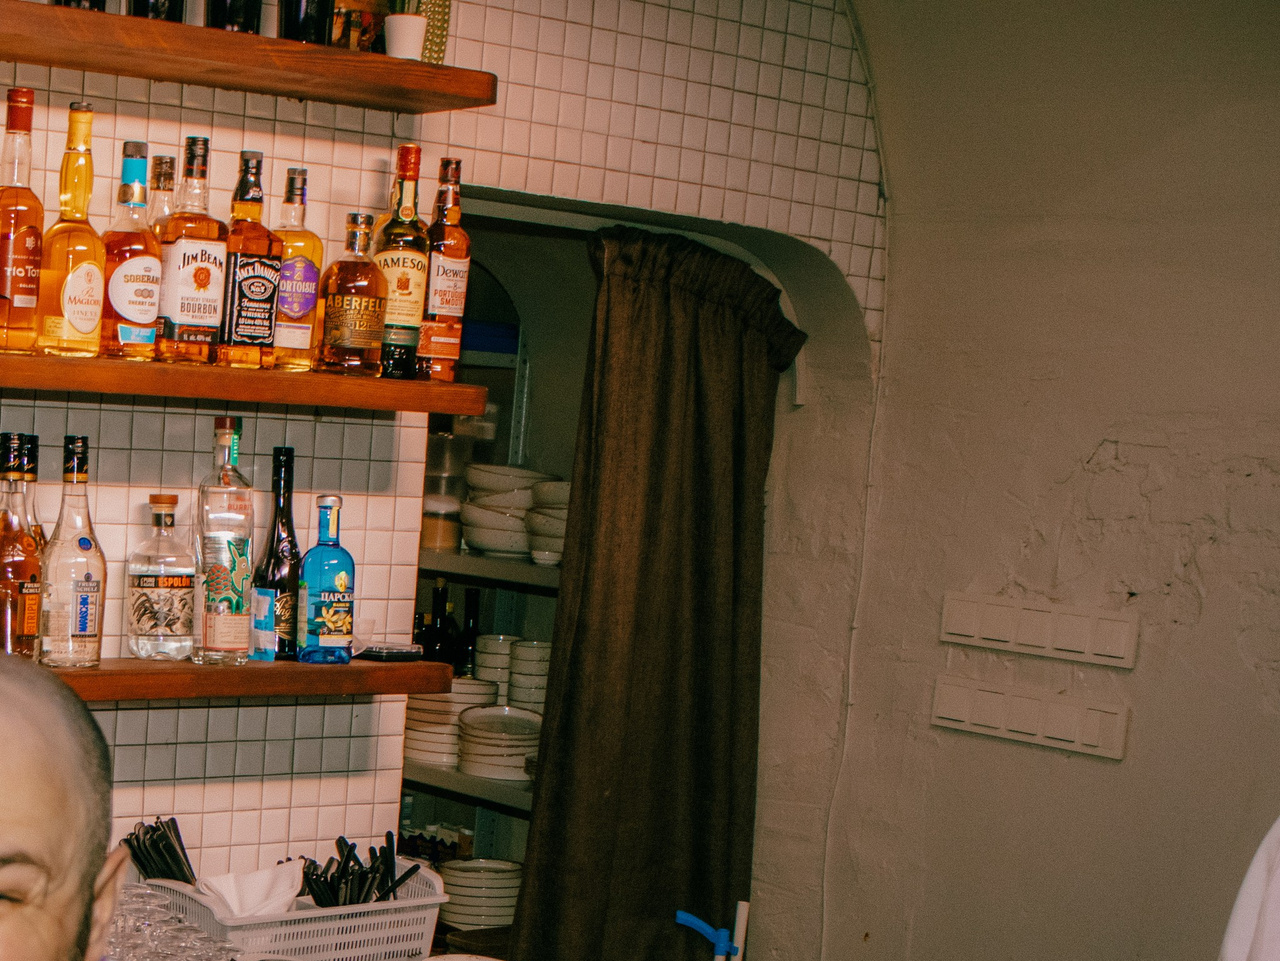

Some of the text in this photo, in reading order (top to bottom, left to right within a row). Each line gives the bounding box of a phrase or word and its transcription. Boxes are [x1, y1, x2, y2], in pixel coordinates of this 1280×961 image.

[178, 249, 223, 272] JIM BEAM
[236, 264, 254, 281] JACK
[124, 275, 160, 285] SOBERAN
[180, 302, 218, 314] BOURBON
[327, 295, 386, 311] ABERFELD
[241, 311, 269, 319] WHISKEY
[355, 320, 367, 331] 12
[321, 592, 354, 603] ЦАРСК
